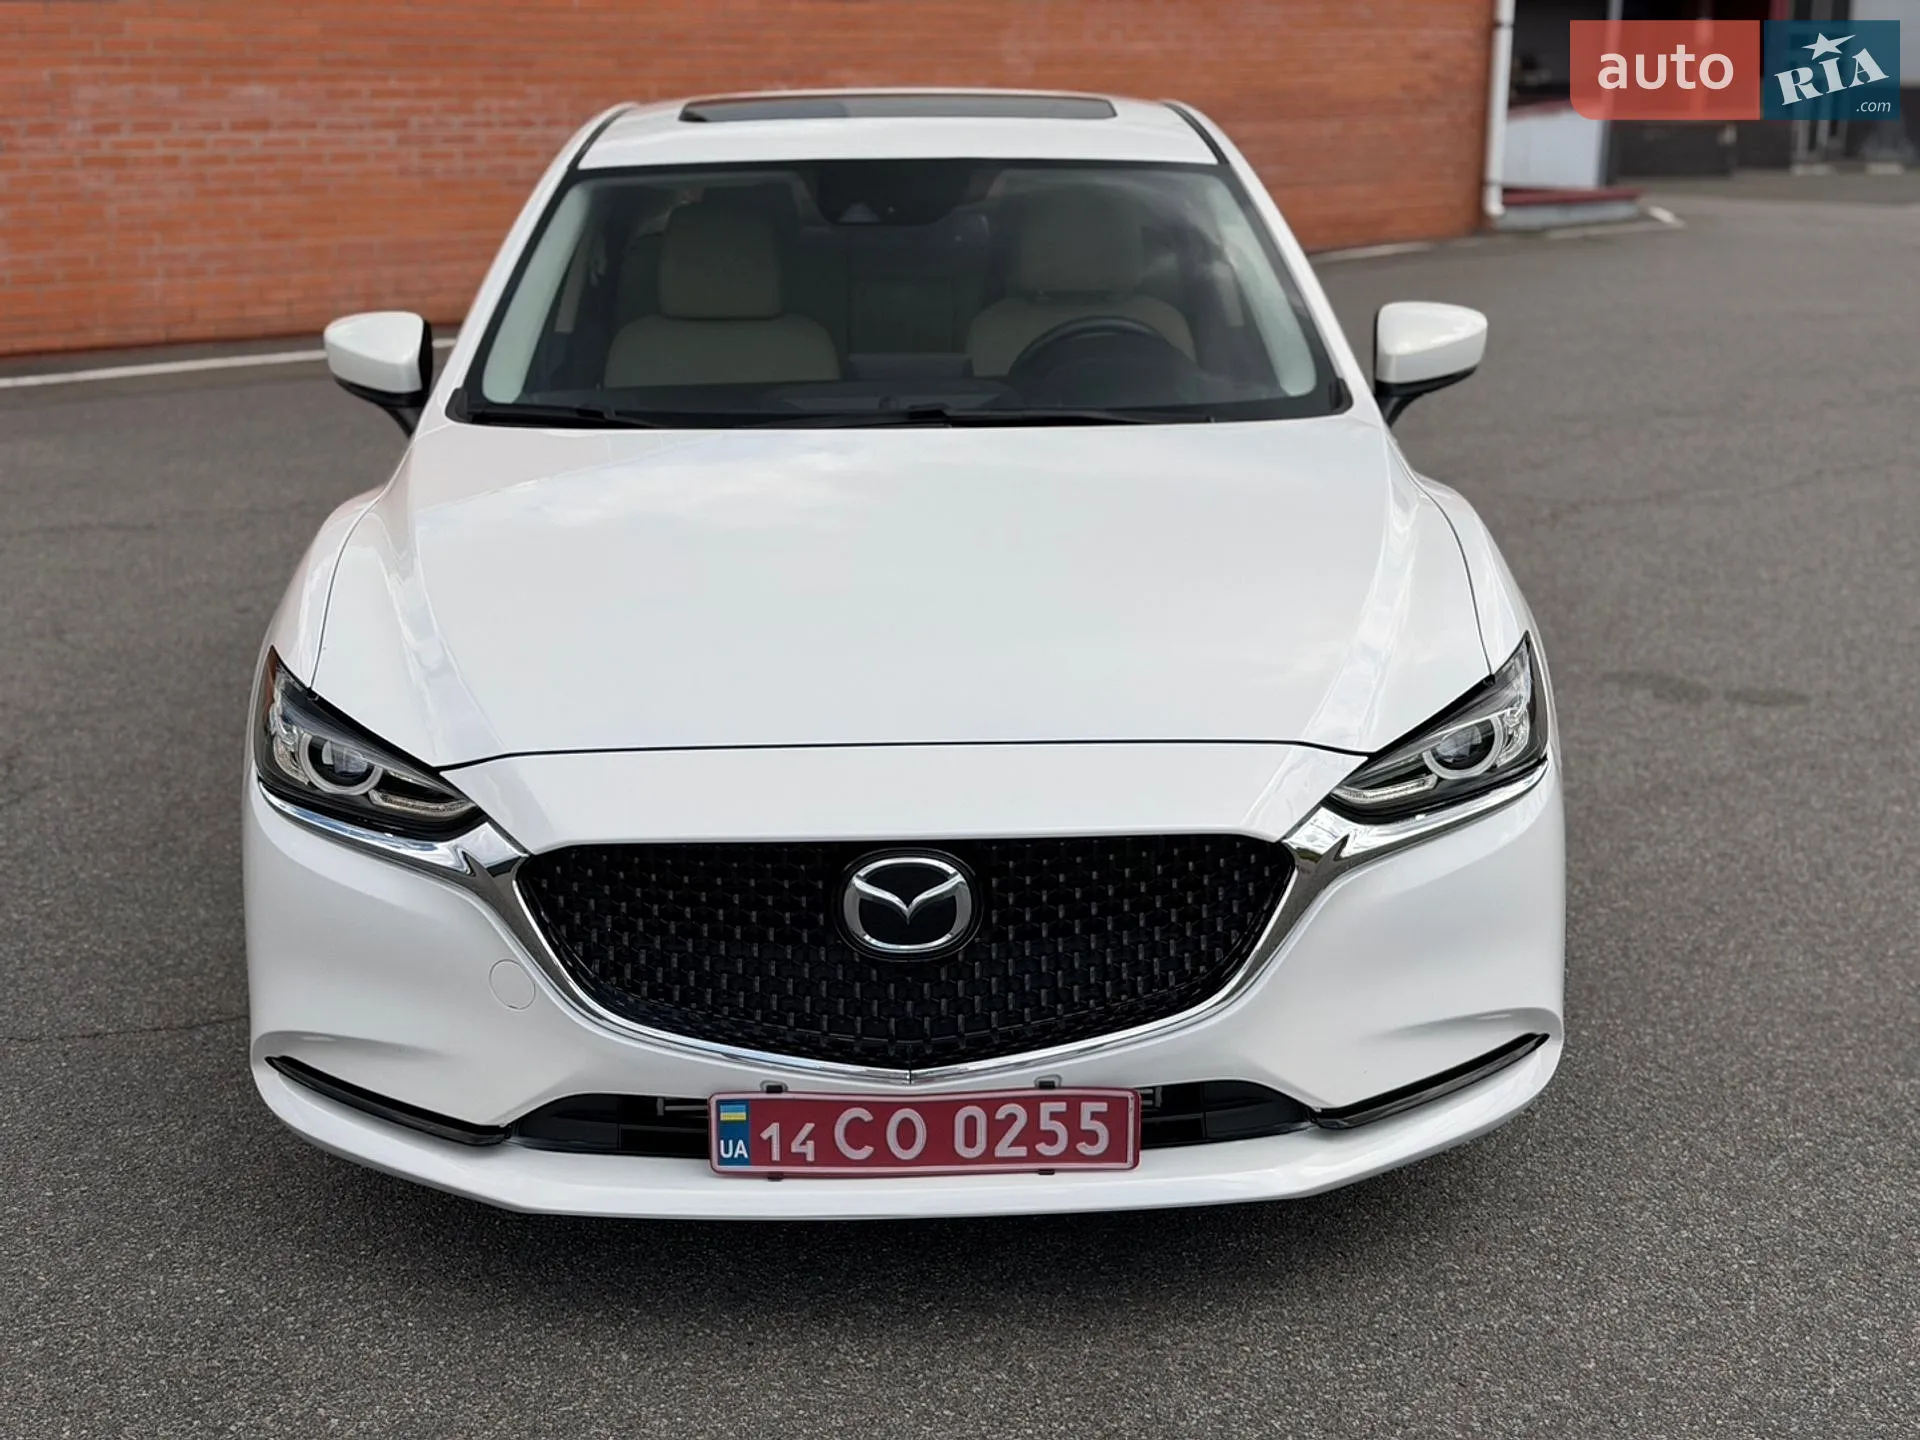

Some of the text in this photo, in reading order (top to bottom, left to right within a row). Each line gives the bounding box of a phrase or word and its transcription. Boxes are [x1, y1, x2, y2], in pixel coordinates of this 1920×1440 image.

[720, 1140, 749, 1159] UA
[760, 1102, 1110, 1161] 14 CO 0255
